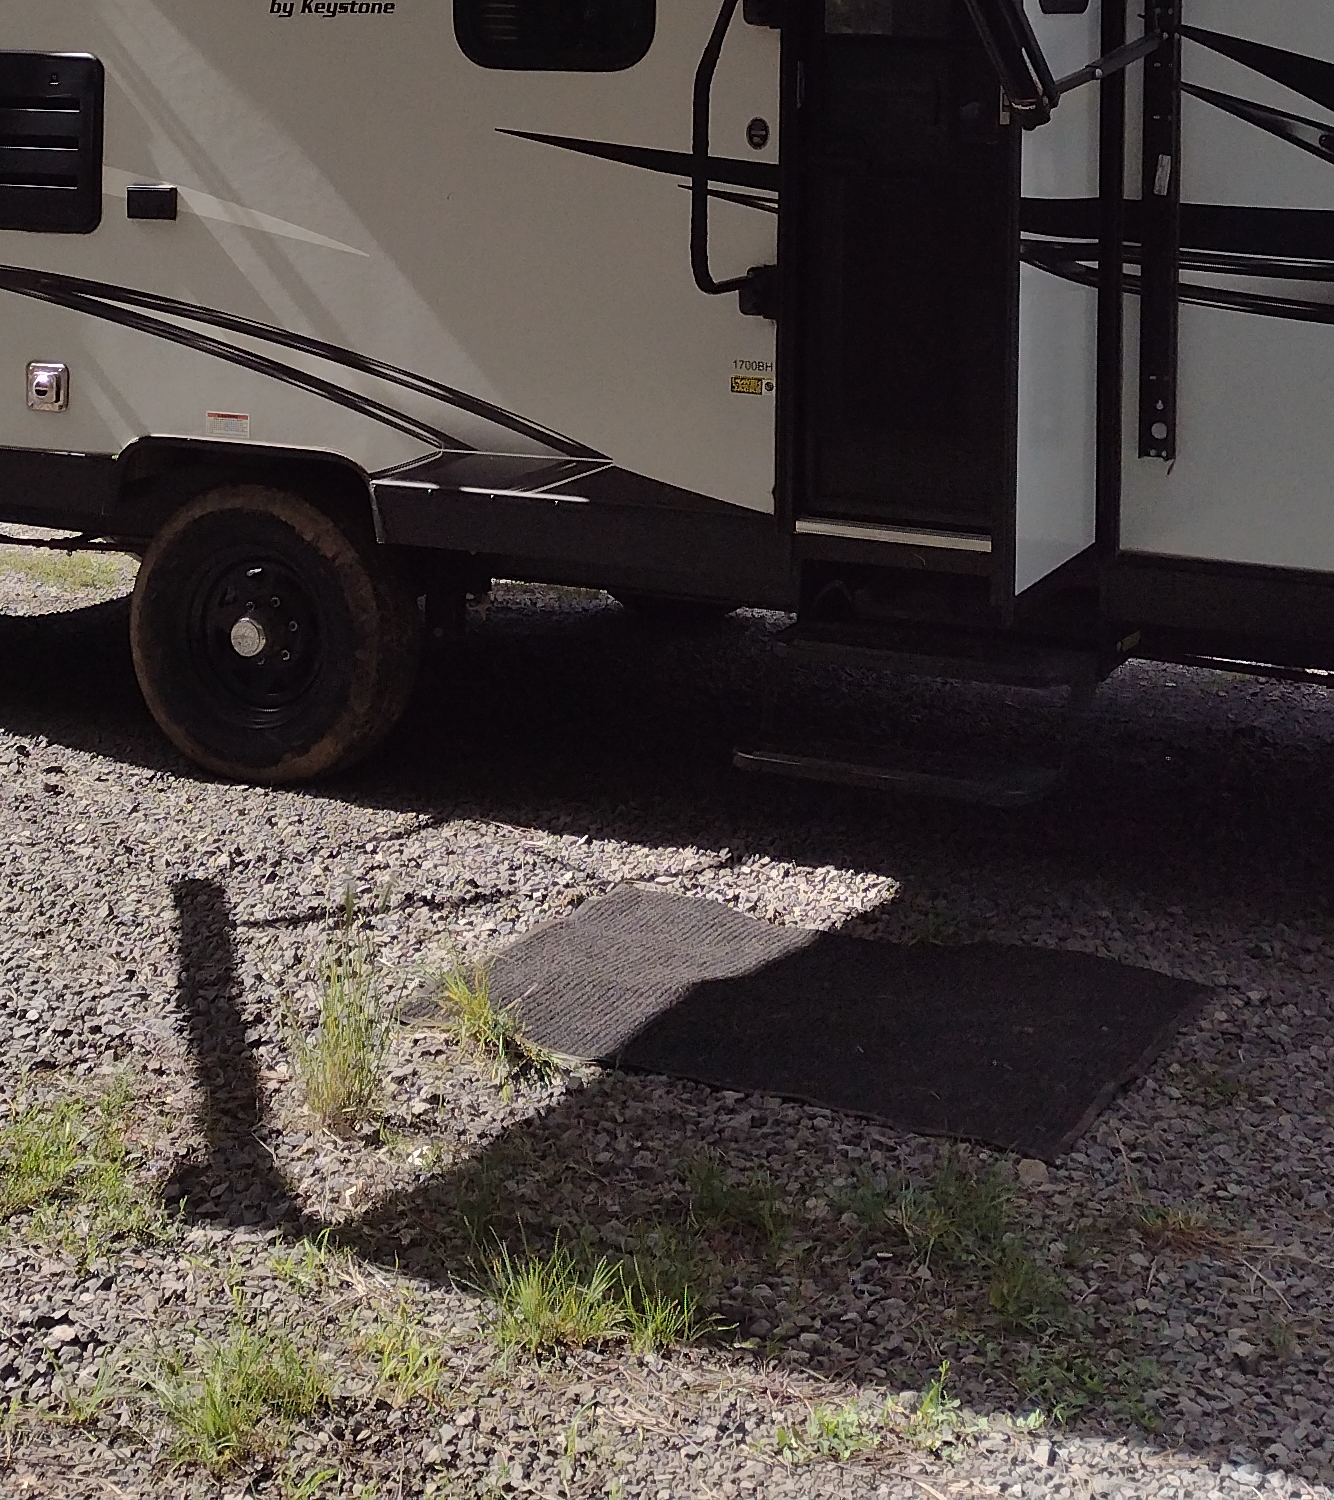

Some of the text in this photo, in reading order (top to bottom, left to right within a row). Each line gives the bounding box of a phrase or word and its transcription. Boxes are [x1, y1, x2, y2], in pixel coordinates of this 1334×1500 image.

[269, 0, 395, 18] by Keystone
[732, 360, 773, 372] 1700BH
